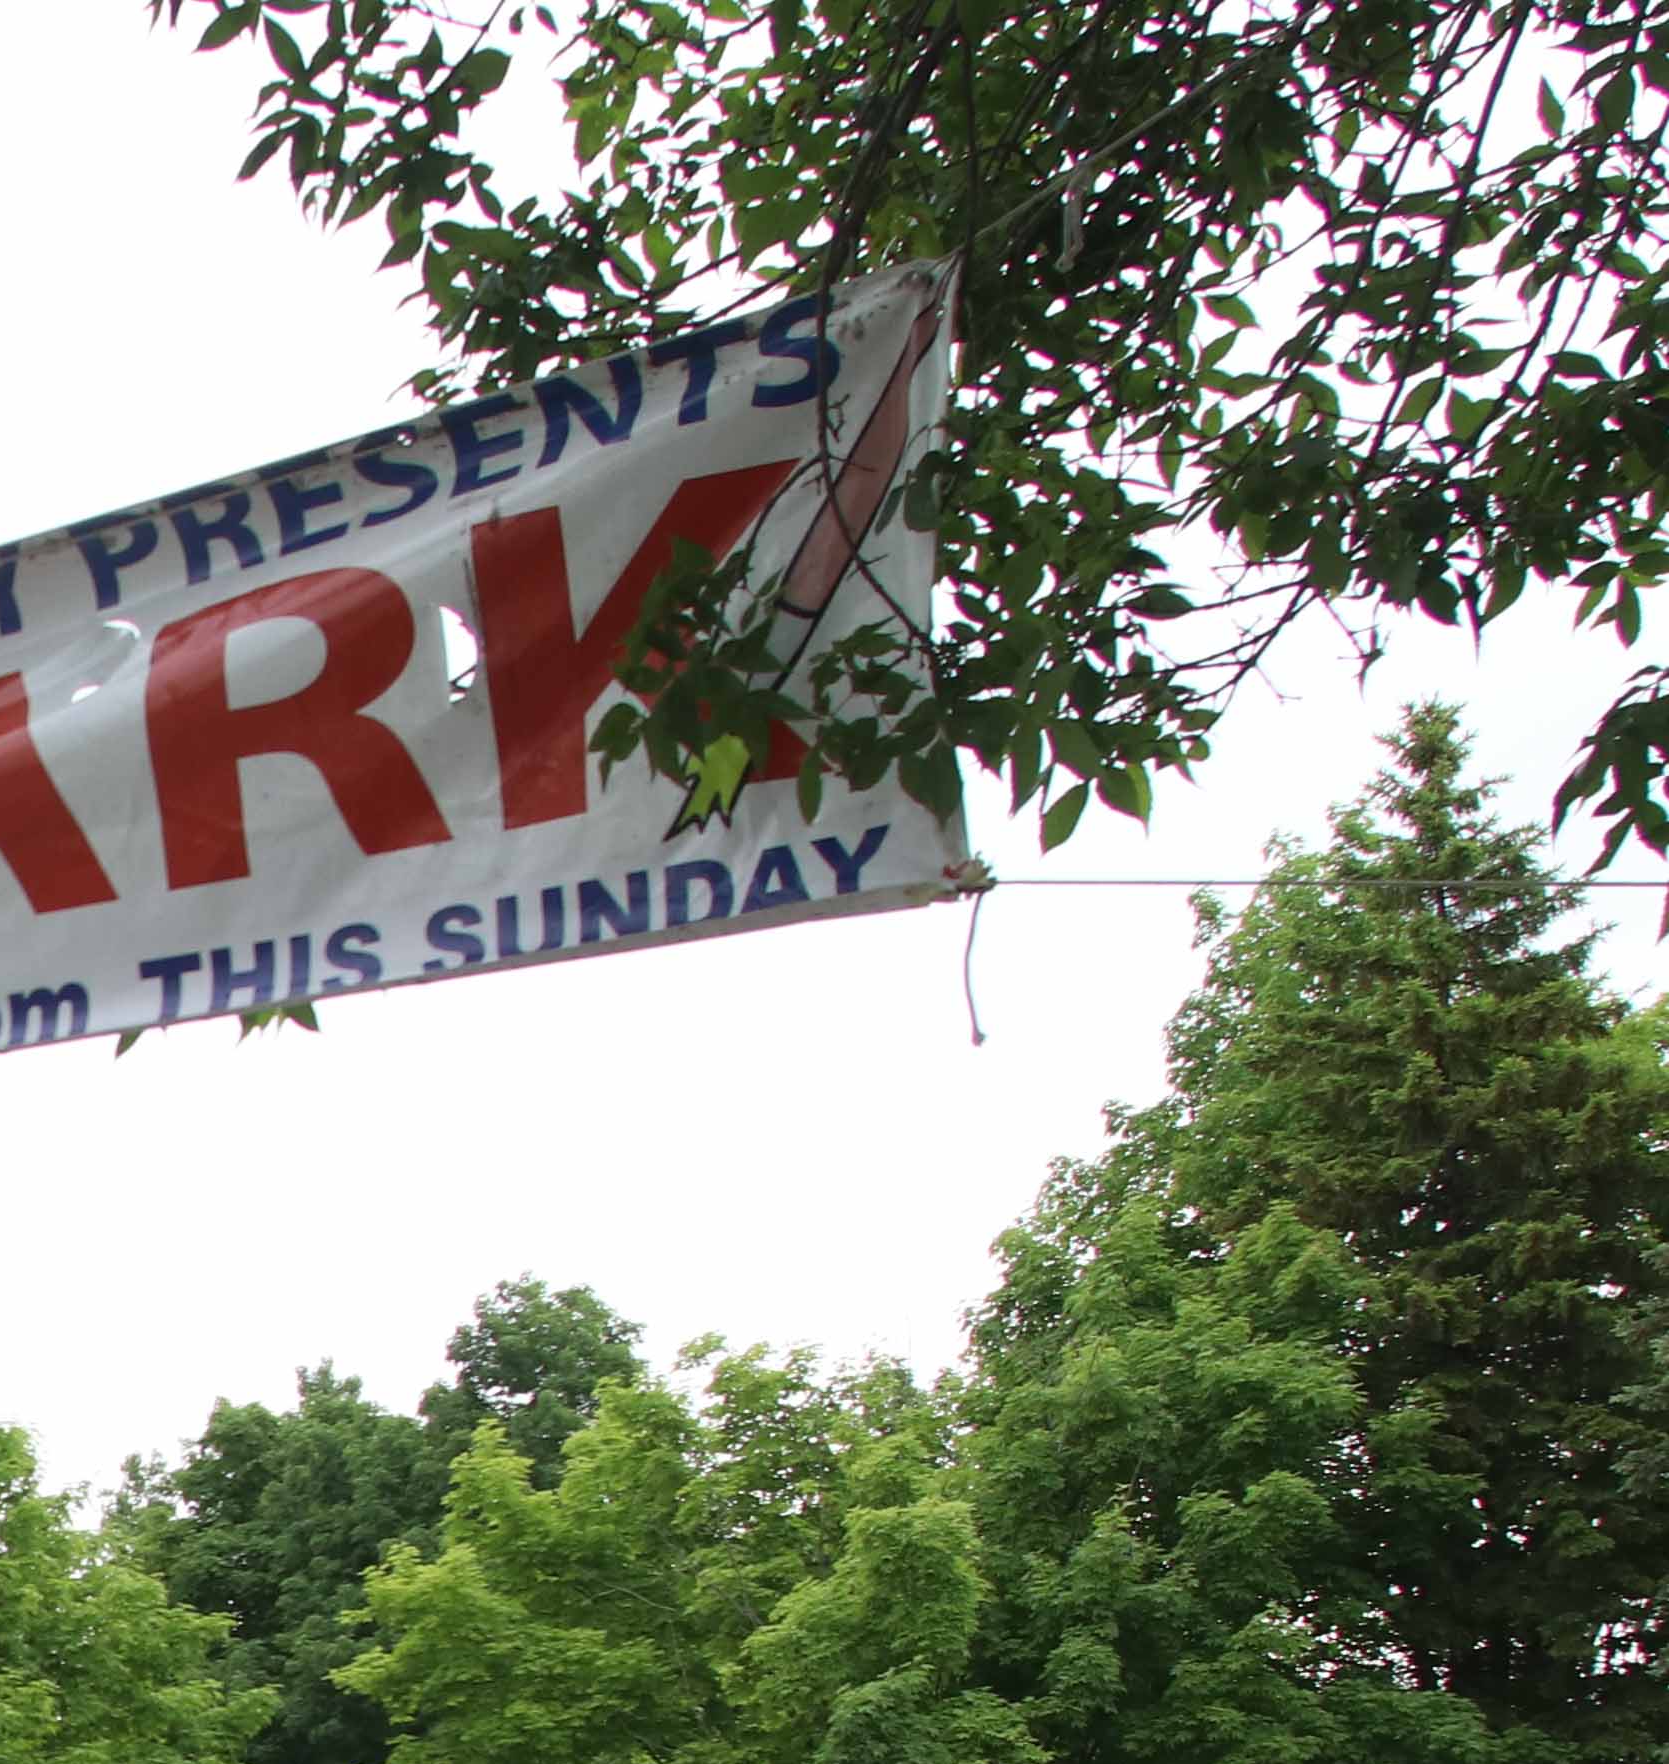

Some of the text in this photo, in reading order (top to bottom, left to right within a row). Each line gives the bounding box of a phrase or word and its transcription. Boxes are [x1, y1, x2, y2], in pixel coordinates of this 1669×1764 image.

[66, 296, 843, 610] PRESENTS
[139, 923, 383, 1027] THIS
[424, 823, 890, 972] SUNDAY
